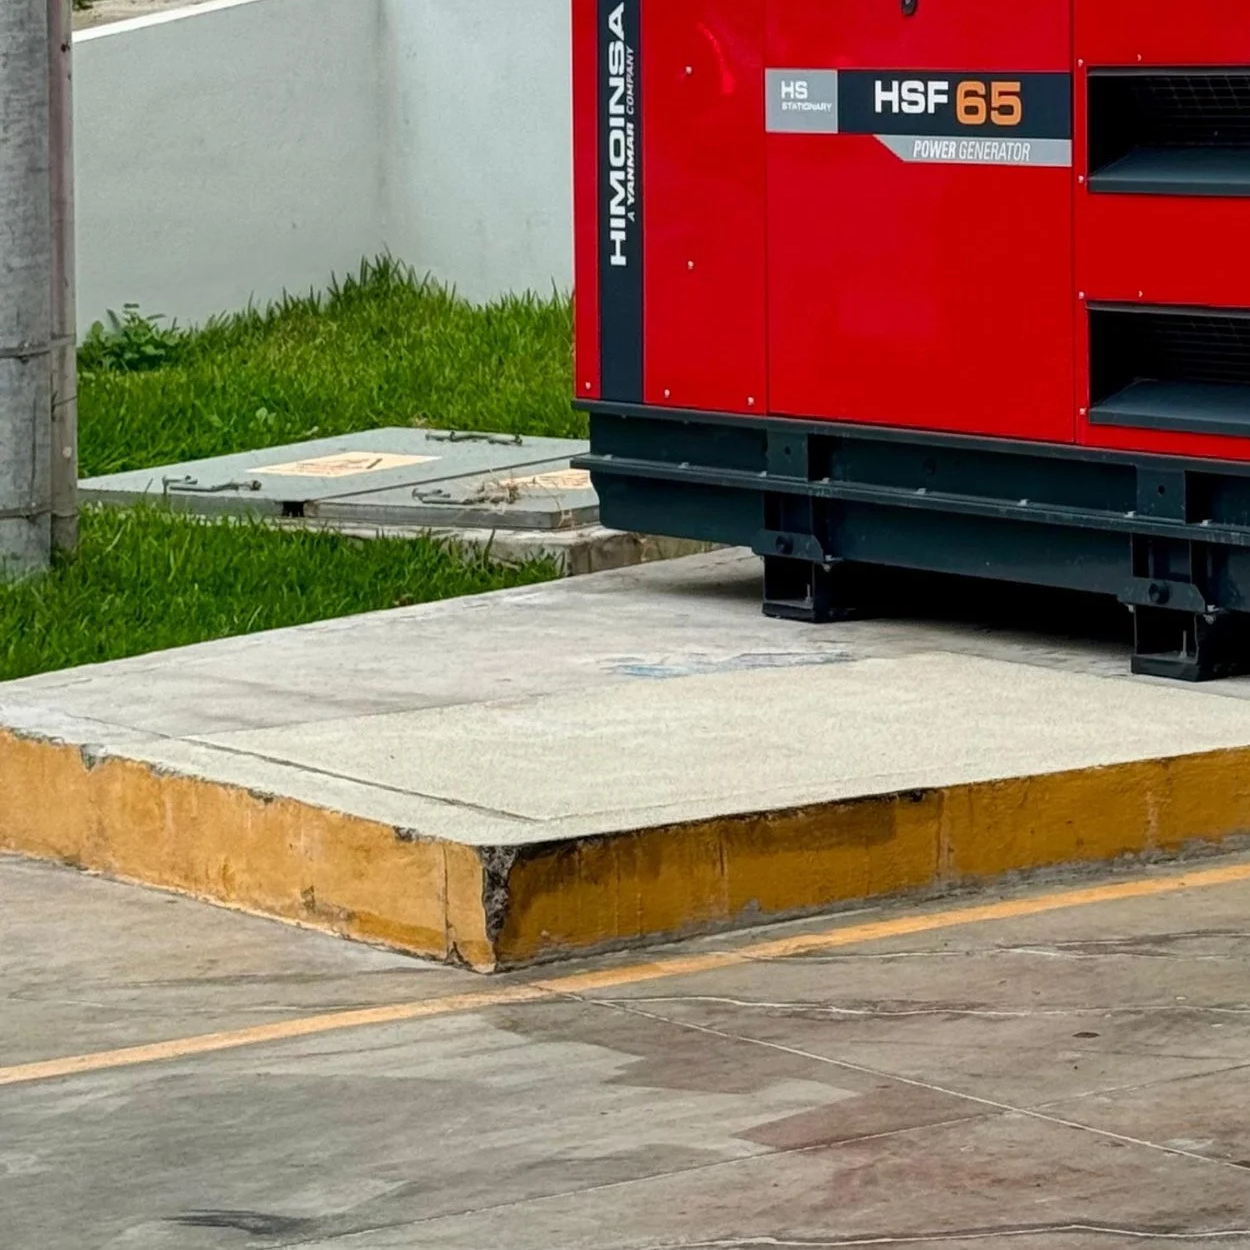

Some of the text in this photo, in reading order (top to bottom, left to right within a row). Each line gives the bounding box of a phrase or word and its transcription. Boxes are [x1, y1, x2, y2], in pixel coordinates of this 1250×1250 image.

[781, 81, 808, 100] HS
[781, 102, 833, 113] STATIONARY
[874, 80, 1022, 126] HSF 65
[608, 2, 627, 266] HIMOINSA
[626, 45, 635, 222] A YANMAR COMPANY
[913, 139, 1031, 162] POWER GENERATOR
